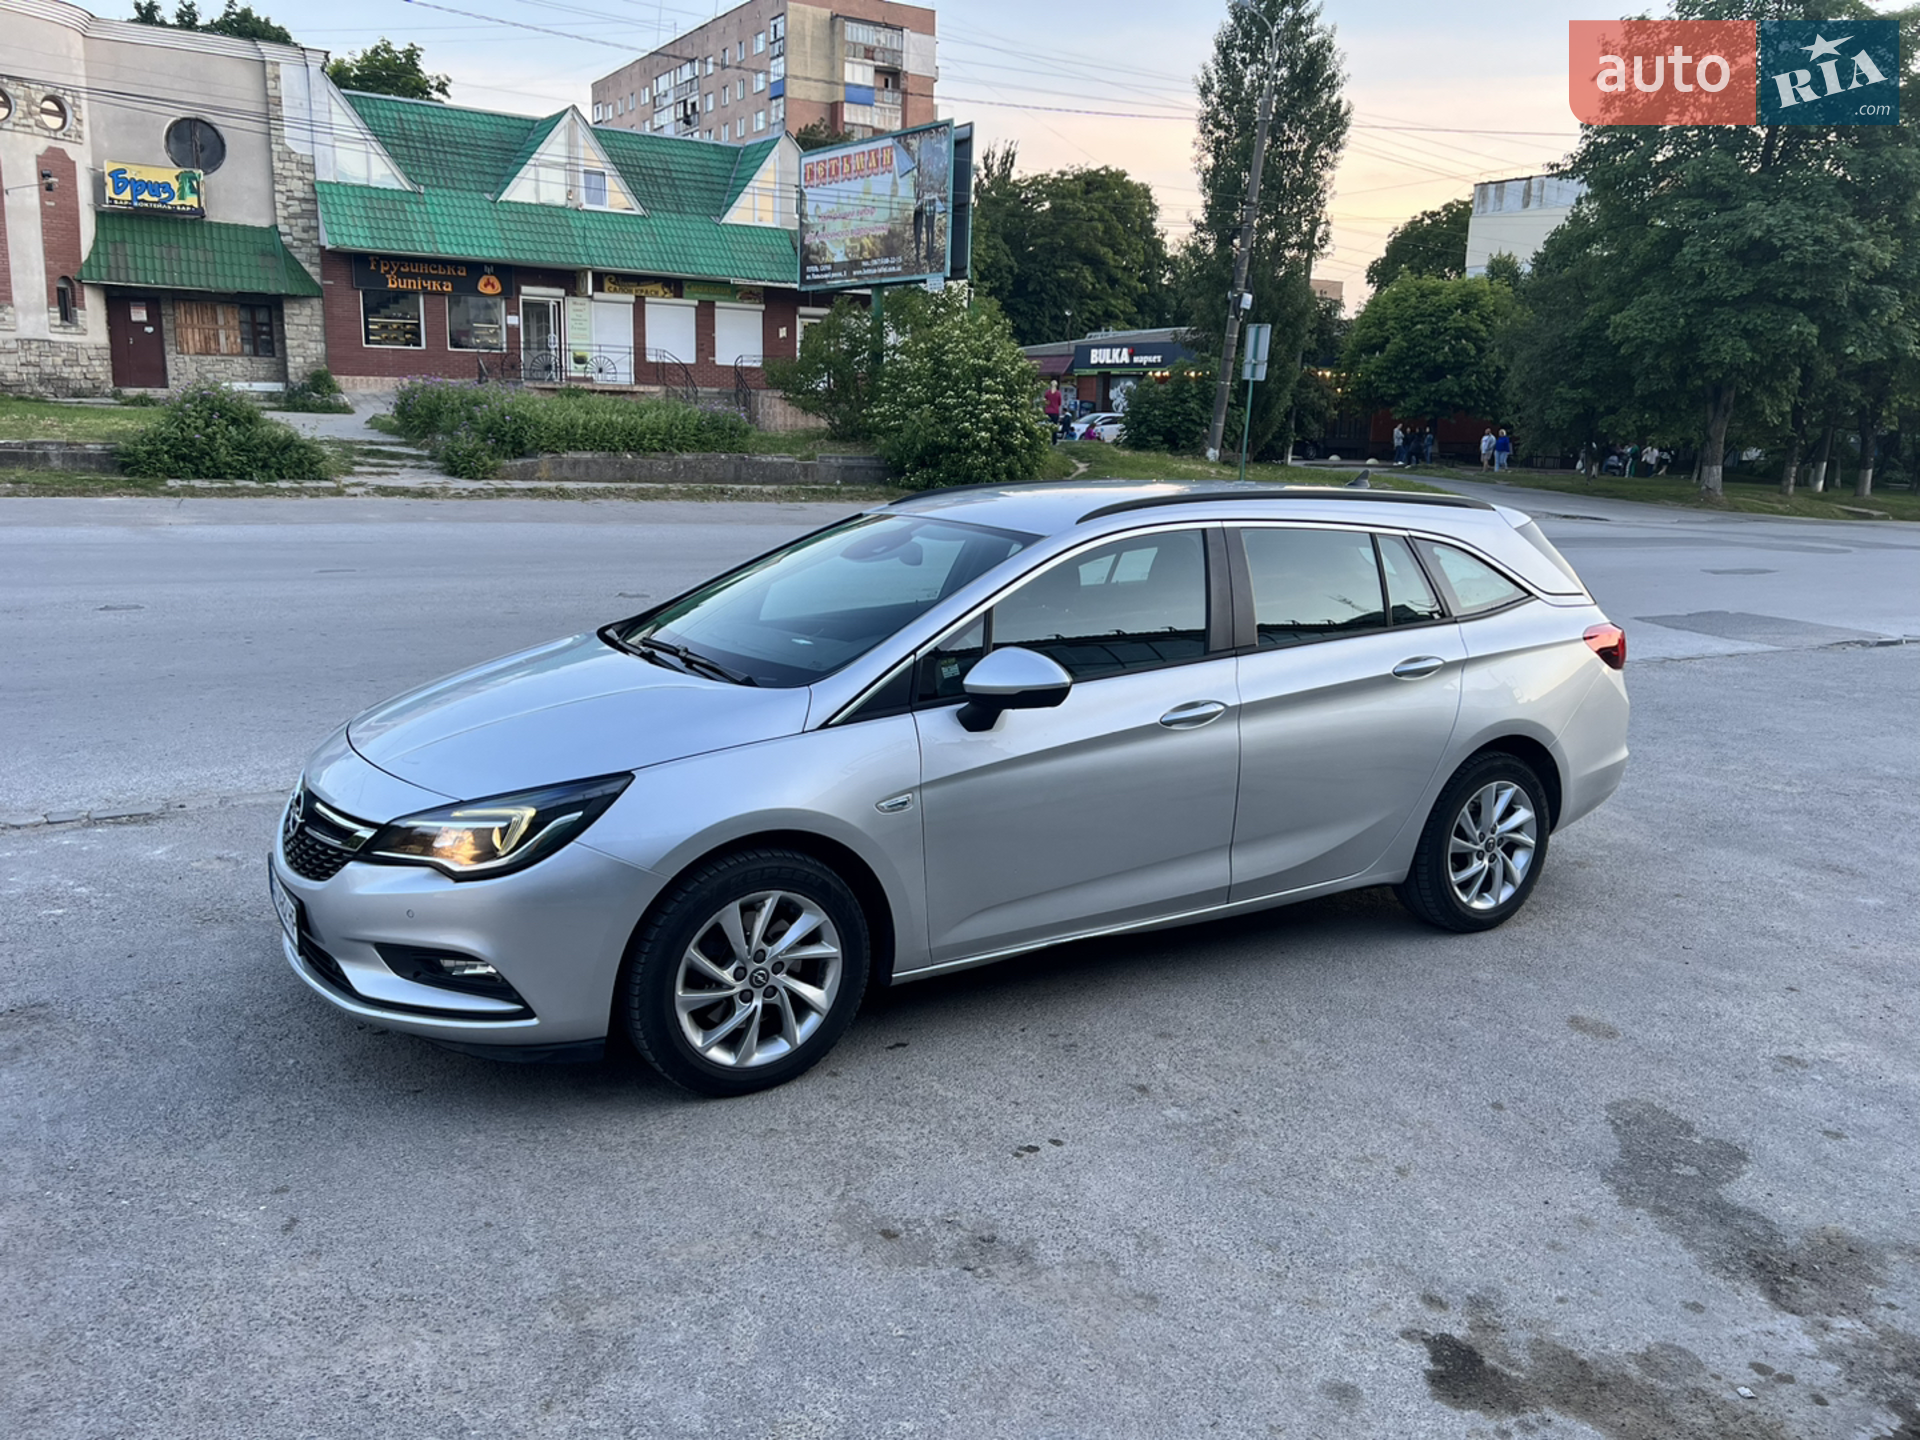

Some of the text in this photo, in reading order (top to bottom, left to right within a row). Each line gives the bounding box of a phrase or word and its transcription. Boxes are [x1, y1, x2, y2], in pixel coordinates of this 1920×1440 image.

[108, 168, 175, 205] Бриз
[369, 256, 468, 277] Грузинська
[386, 274, 454, 293] Випічка
[1090, 348, 1129, 364] BULKA
